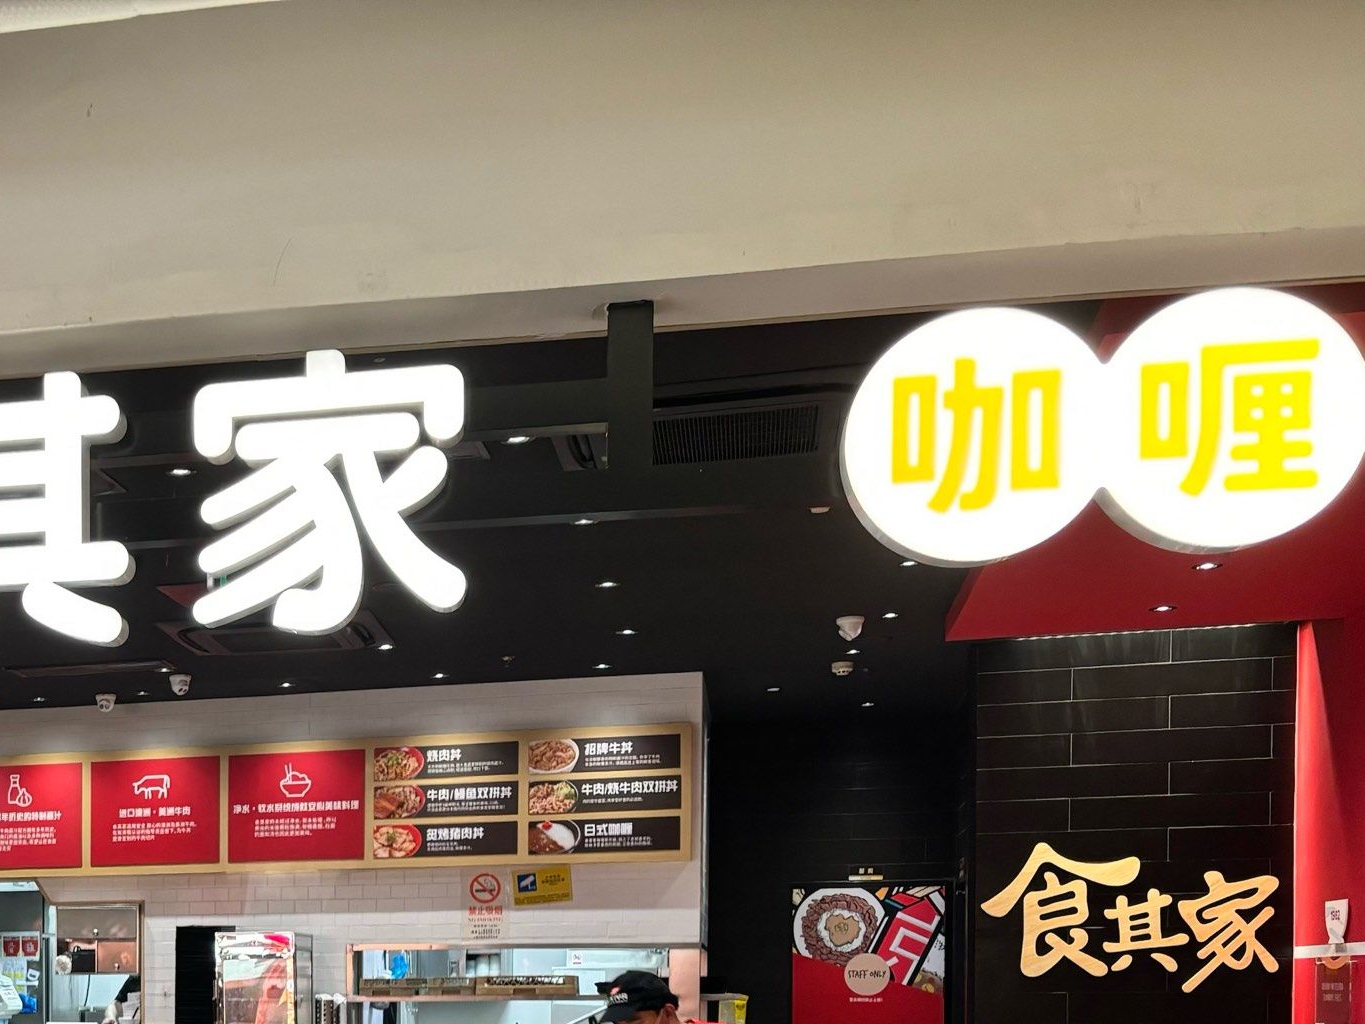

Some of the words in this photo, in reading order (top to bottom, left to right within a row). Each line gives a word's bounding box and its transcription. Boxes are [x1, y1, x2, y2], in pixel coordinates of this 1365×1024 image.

[891, 337, 1321, 514] 咖喱
[584, 740, 633, 755] 招牌牛丼
[426, 748, 462, 763] 烧肉丼
[584, 822, 633, 836] 日式咖喱
[980, 841, 1281, 993] 食其家
[847, 969, 868, 979] STAFF
